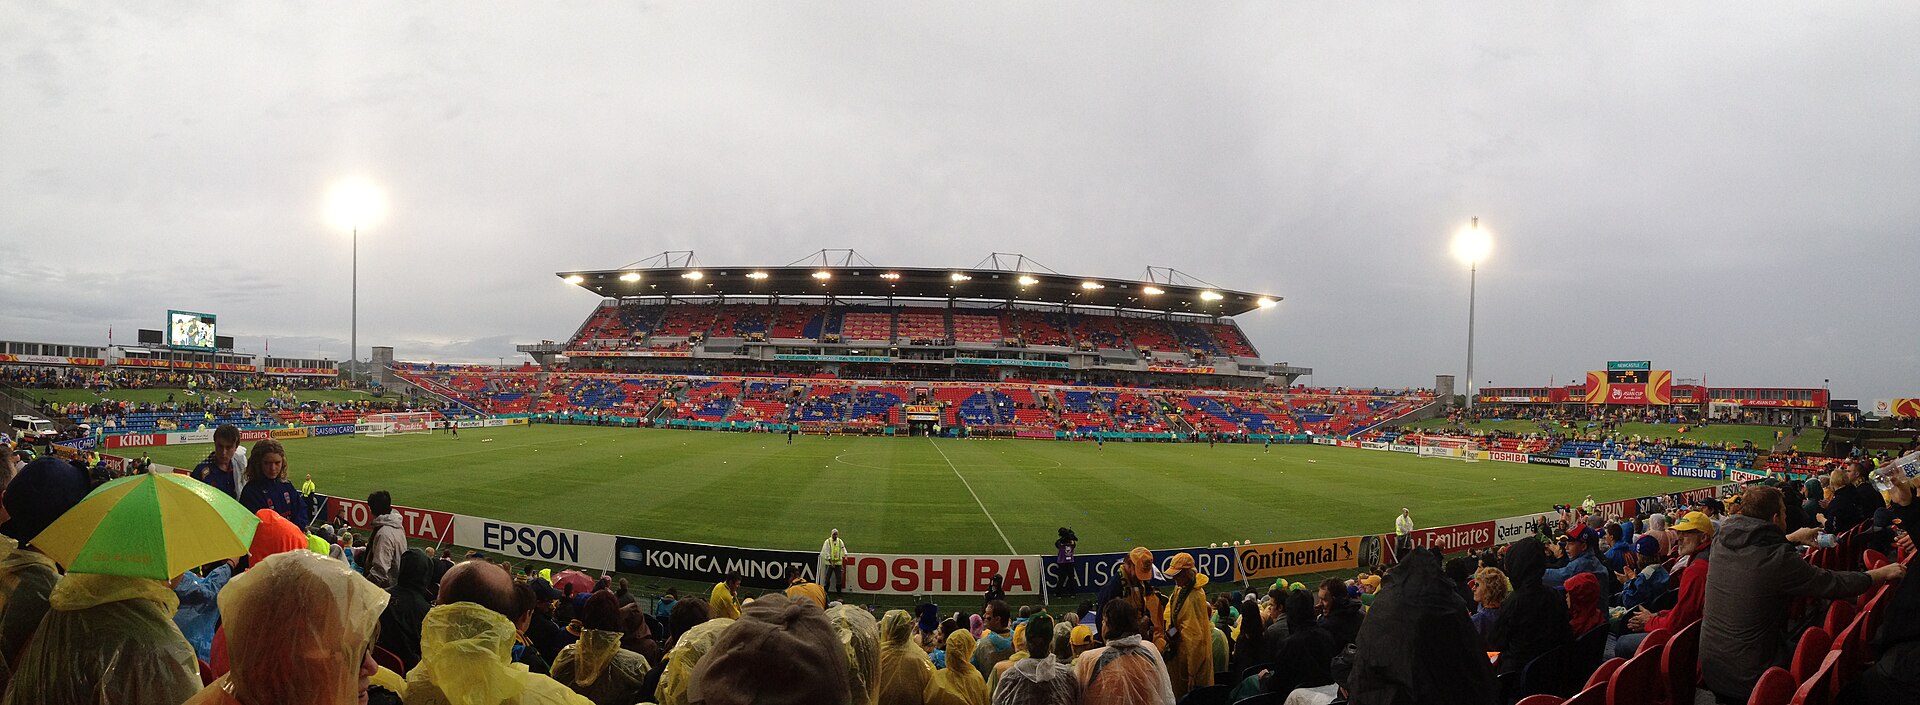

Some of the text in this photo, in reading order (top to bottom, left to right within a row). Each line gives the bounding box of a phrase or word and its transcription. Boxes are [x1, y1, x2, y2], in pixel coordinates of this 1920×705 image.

[271, 429, 300, 439] Continental
[315, 425, 355, 435] SAISON CARD
[120, 434, 154, 447] KIRIN
[1490, 452, 1527, 463] TOSHIBA
[1580, 459, 1607, 470] EPSON
[1623, 461, 1662, 475] TOYOTA
[1672, 466, 1717, 479] SAMSUNG
[339, 500, 438, 539] TOTA
[1601, 502, 1624, 521] IRIN
[1497, 522, 1524, 541] Qatar
[484, 522, 579, 564] EPSON
[646, 549, 722, 574] KONICA
[1161, 553, 1231, 581] CRD
[1238, 543, 1338, 577] Continental
